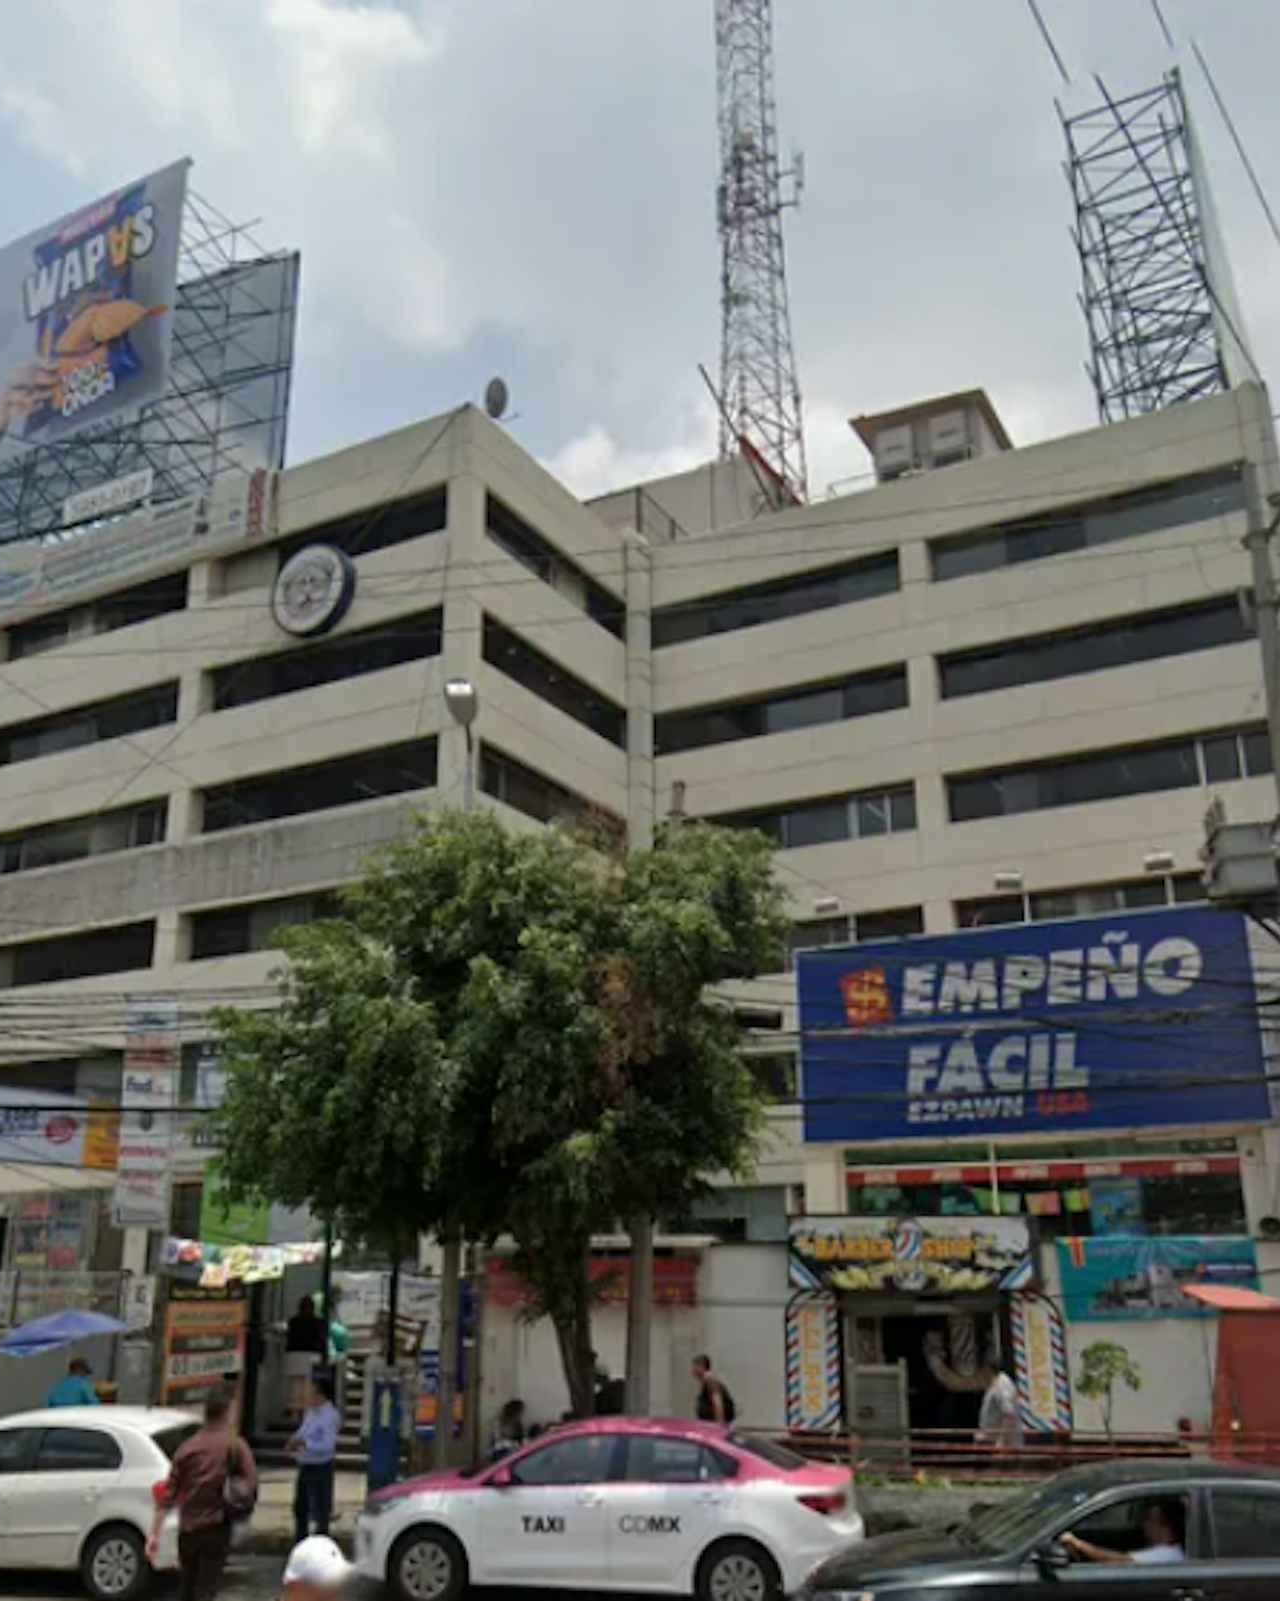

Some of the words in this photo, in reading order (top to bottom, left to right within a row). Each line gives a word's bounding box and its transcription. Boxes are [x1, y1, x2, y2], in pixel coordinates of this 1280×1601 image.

[901, 930, 1202, 1017] EMPEÑO
[907, 1027, 1090, 1095] FÁCIL
[907, 1096, 1024, 1124] EZPAWN
[1037, 1092, 1090, 1117] USA
[814, 1237, 893, 1261] BARBER
[921, 1237, 976, 1260] SHOP
[520, 1516, 566, 1534] TAXI
[619, 1515, 682, 1534] CDMX
